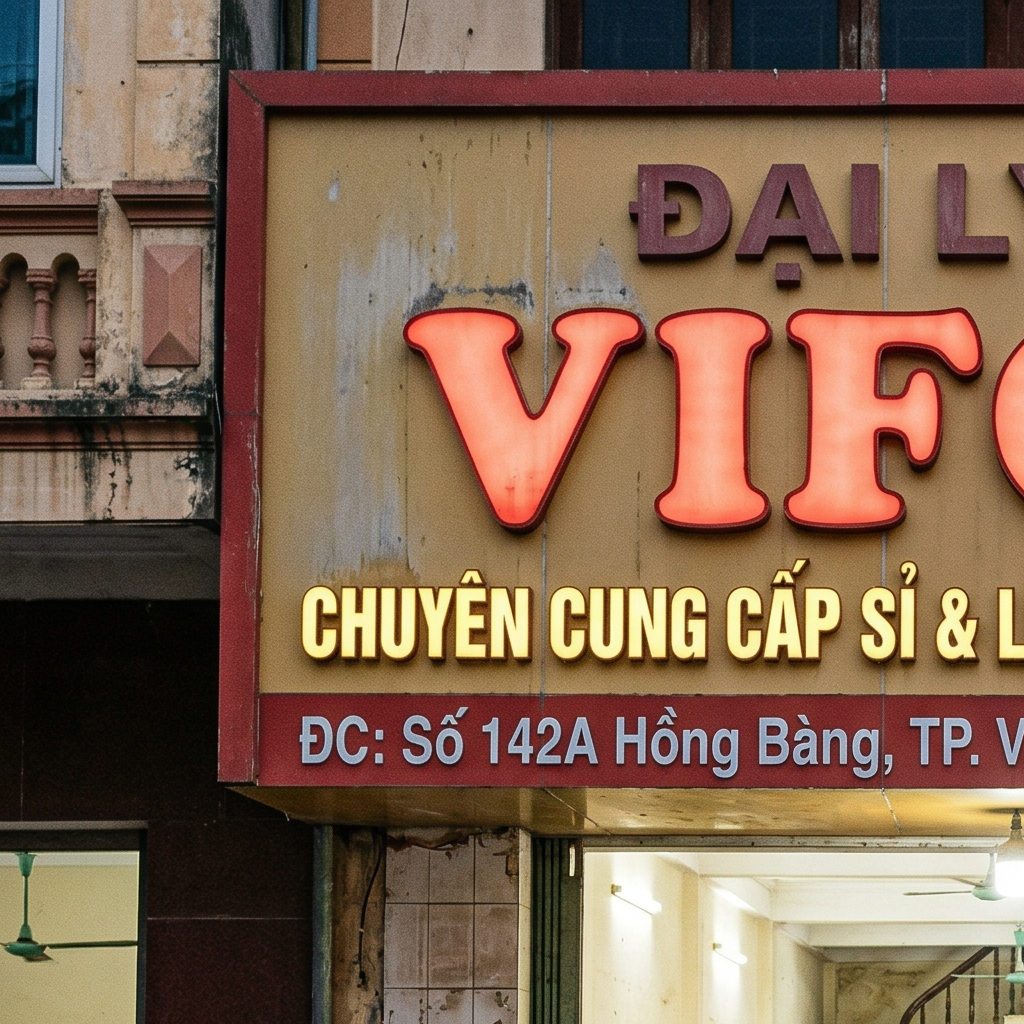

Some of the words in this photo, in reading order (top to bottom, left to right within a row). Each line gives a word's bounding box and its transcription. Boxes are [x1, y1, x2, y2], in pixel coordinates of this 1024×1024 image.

[629, 163, 881, 289] ĐẠI
[301, 570, 532, 662] CHUYÊN
[549, 586, 708, 662] CUNG
[725, 559, 842, 662] CẤP
[859, 561, 917, 662] SỈ
[935, 587, 979, 662] &
[300, 715, 386, 765] ĐC:
[402, 707, 469, 765] Số
[481, 717, 599, 765] 142A
[616, 709, 740, 777] Hồng
[757, 715, 893, 779] Bàng,
[910, 718, 980, 767] TP.
